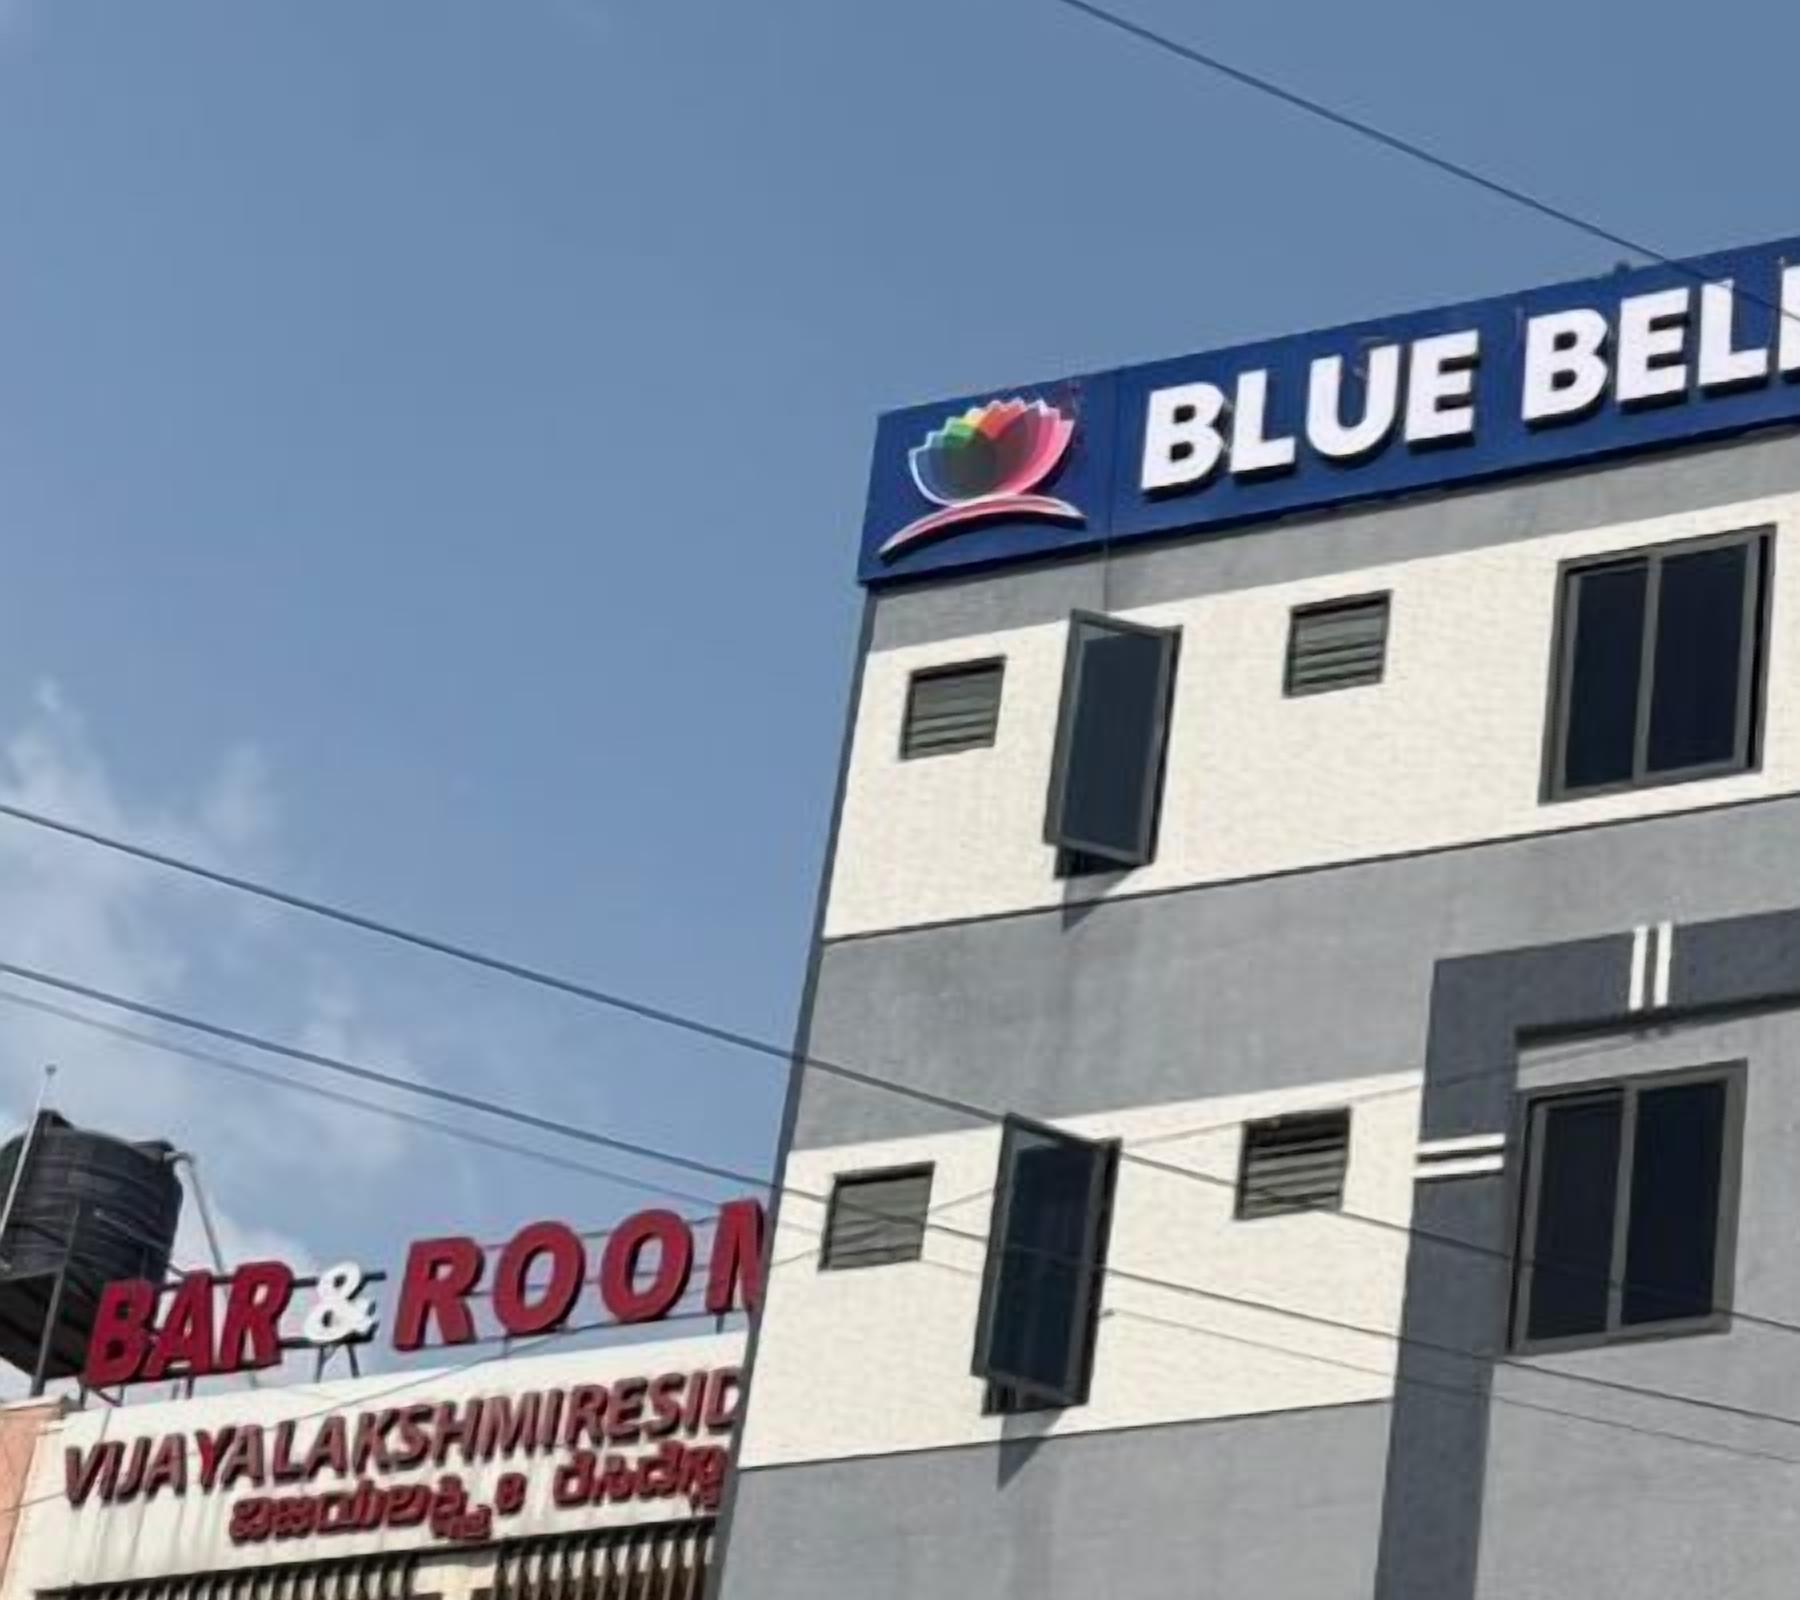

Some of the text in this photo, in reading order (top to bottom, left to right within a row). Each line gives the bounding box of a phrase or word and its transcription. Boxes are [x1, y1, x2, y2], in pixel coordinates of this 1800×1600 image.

[1139, 326, 1482, 498] BLUE
[86, 1261, 293, 1387] BAR
[302, 1261, 380, 1344] &
